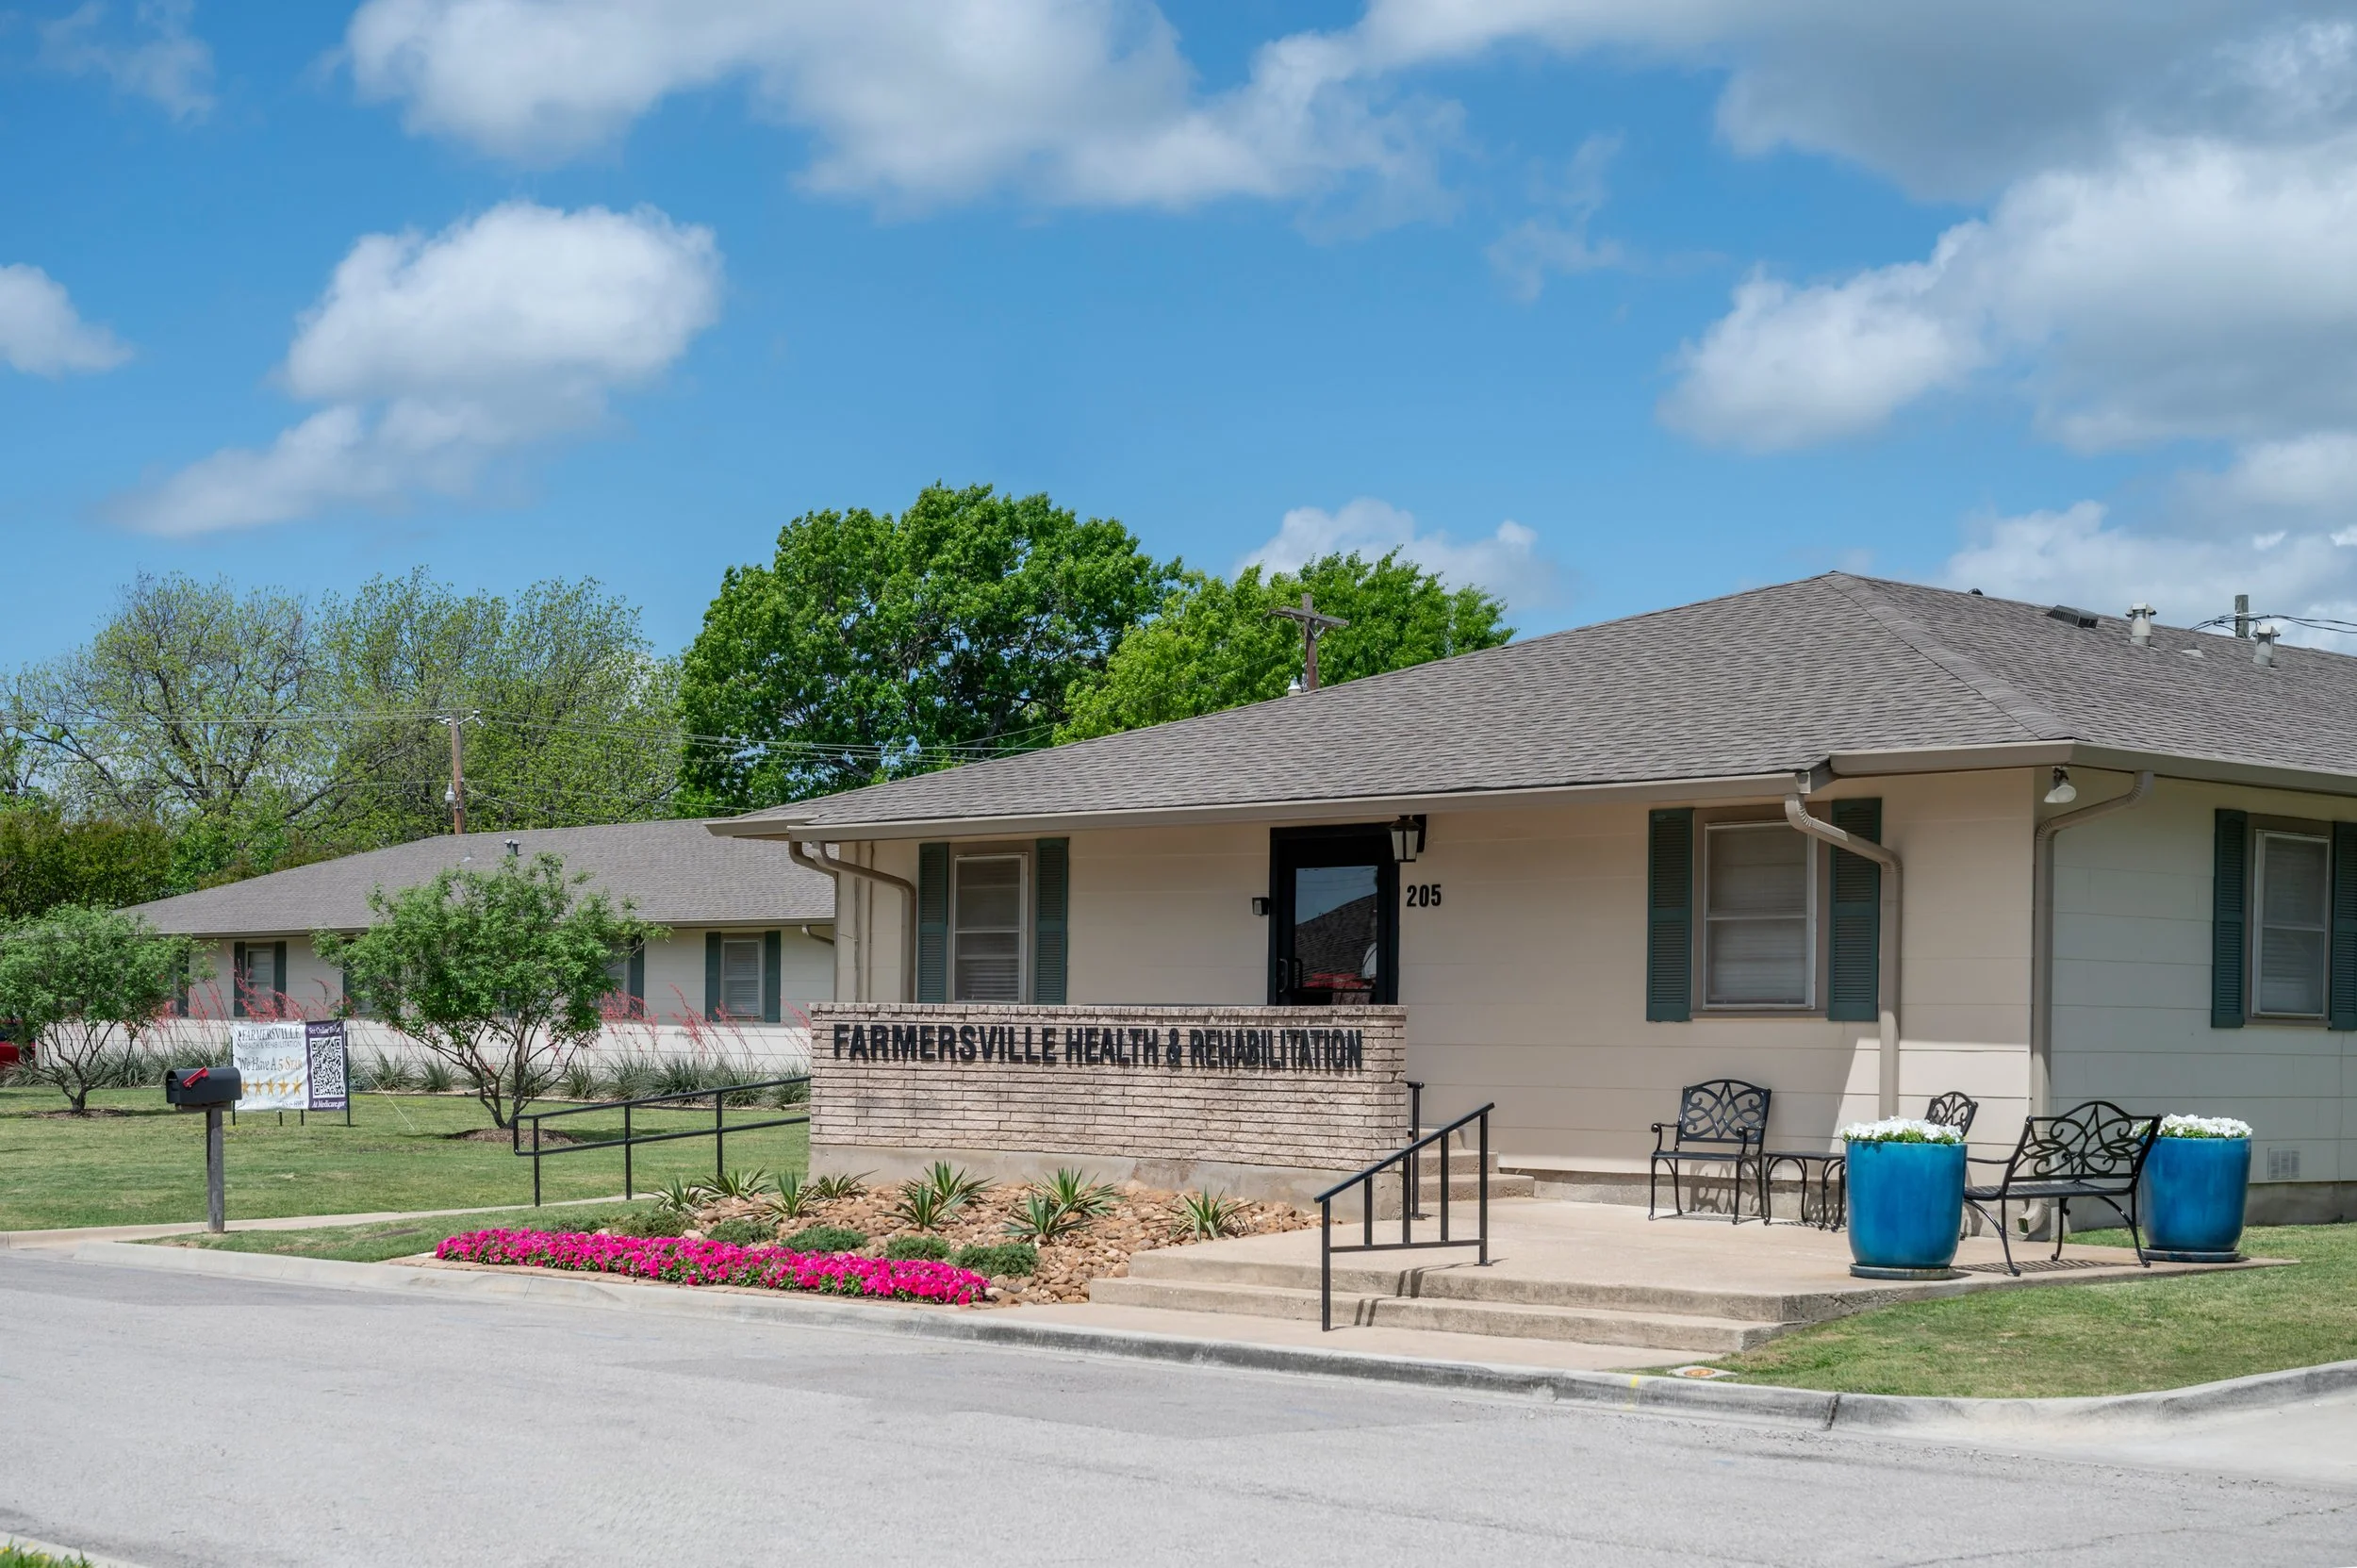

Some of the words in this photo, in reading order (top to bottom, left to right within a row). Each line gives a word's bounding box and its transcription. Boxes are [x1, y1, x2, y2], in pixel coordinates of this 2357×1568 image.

[1407, 883, 1442, 907] 205
[242, 1028, 302, 1041] FARMERSVILLE
[833, 1024, 1057, 1063] FARMERSVILLE
[1065, 1027, 1159, 1064] HEALTH
[1166, 1028, 1181, 1065] &
[1189, 1029, 1362, 1068] REHABILITATION
[239, 1058, 251, 1071] We
[252, 1058, 270, 1071] Have
[272, 1057, 277, 1071] A
[278, 1058, 284, 1072] 5
